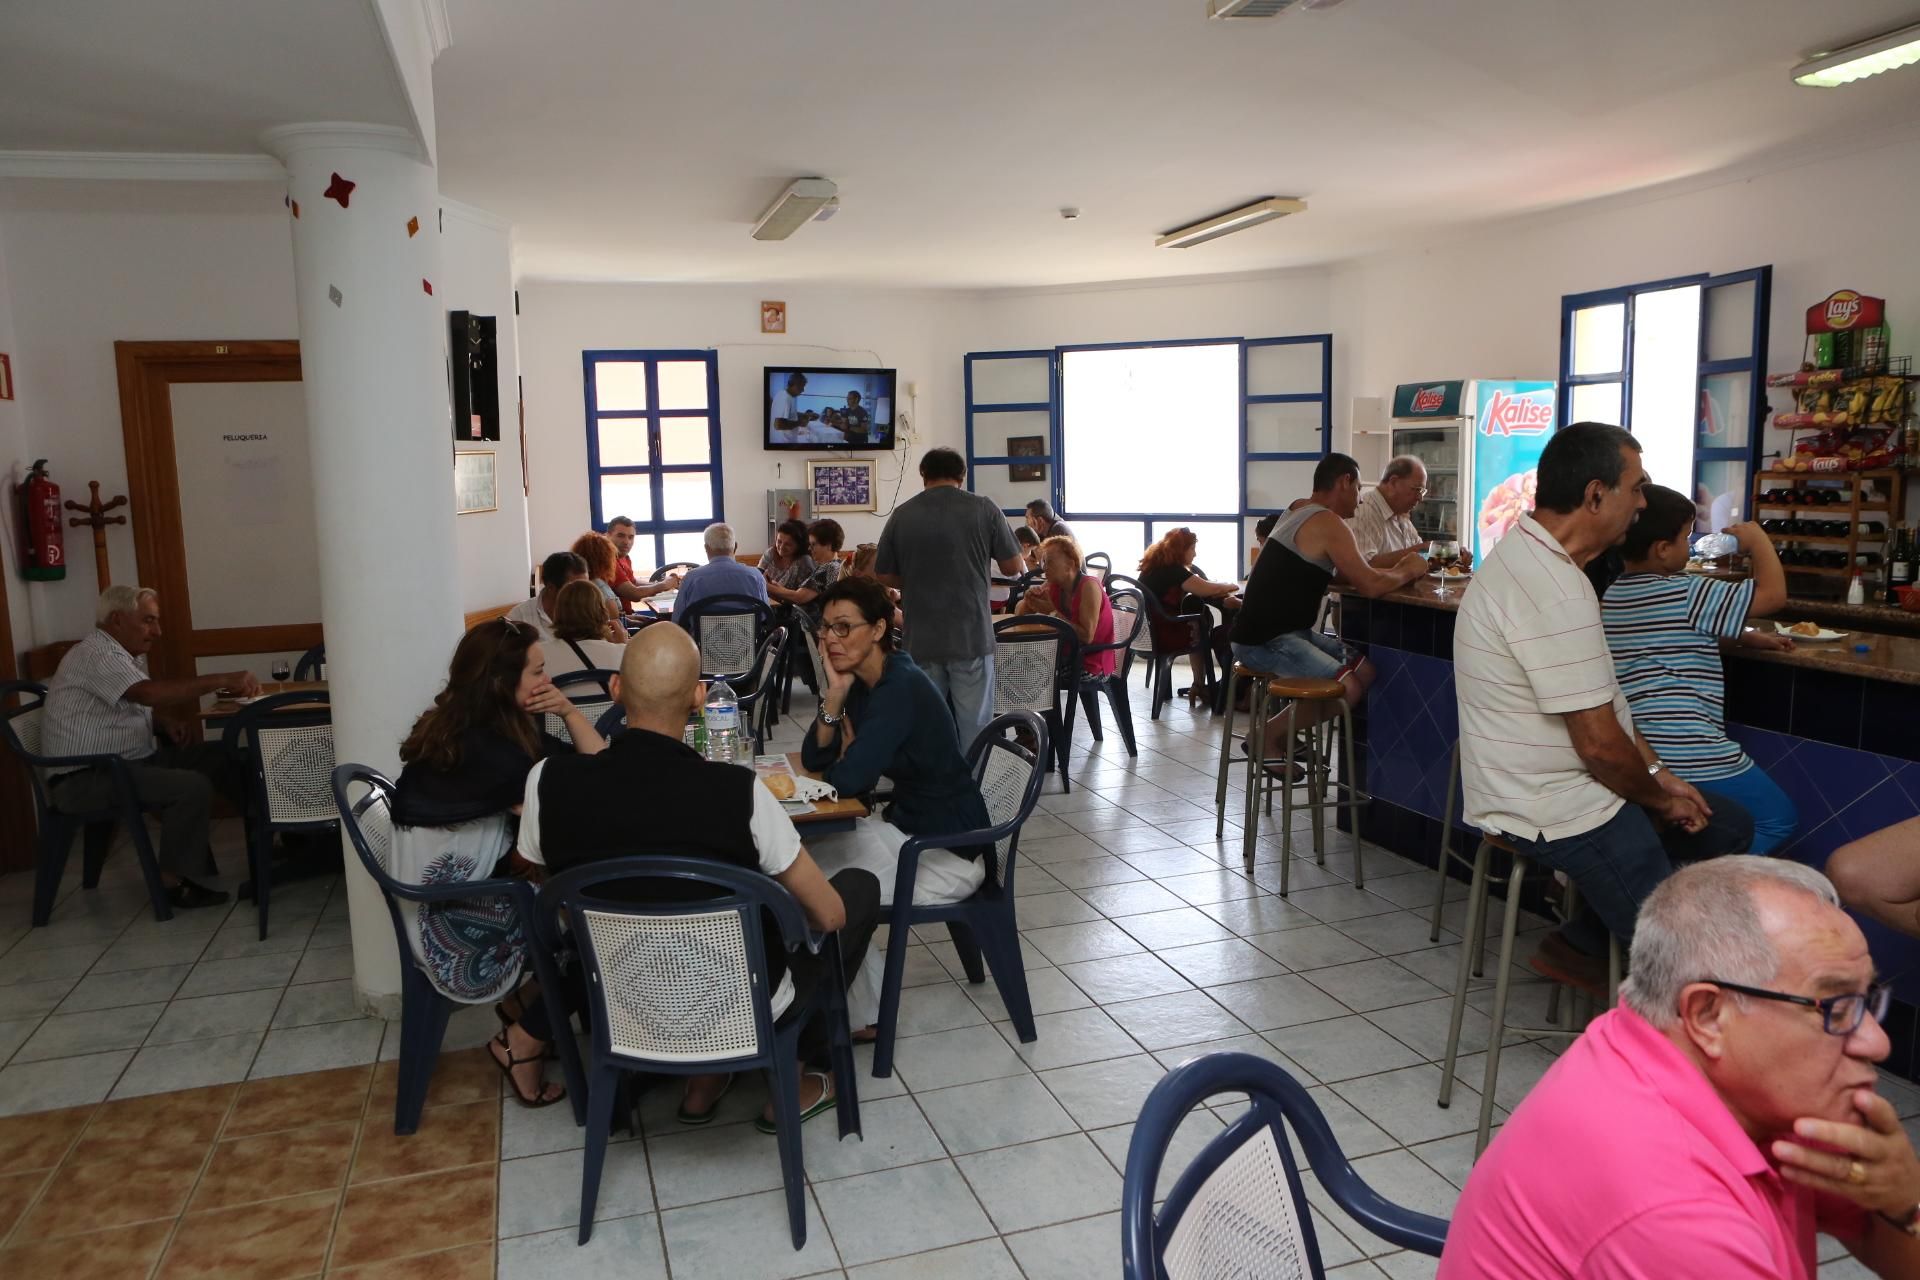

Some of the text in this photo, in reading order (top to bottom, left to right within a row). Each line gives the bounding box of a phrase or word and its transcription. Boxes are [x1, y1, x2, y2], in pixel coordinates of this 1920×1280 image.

[1413, 388, 1444, 411] Kalise
[1486, 391, 1552, 436] Kalise
[223, 433, 268, 442] PELUQUERIA
